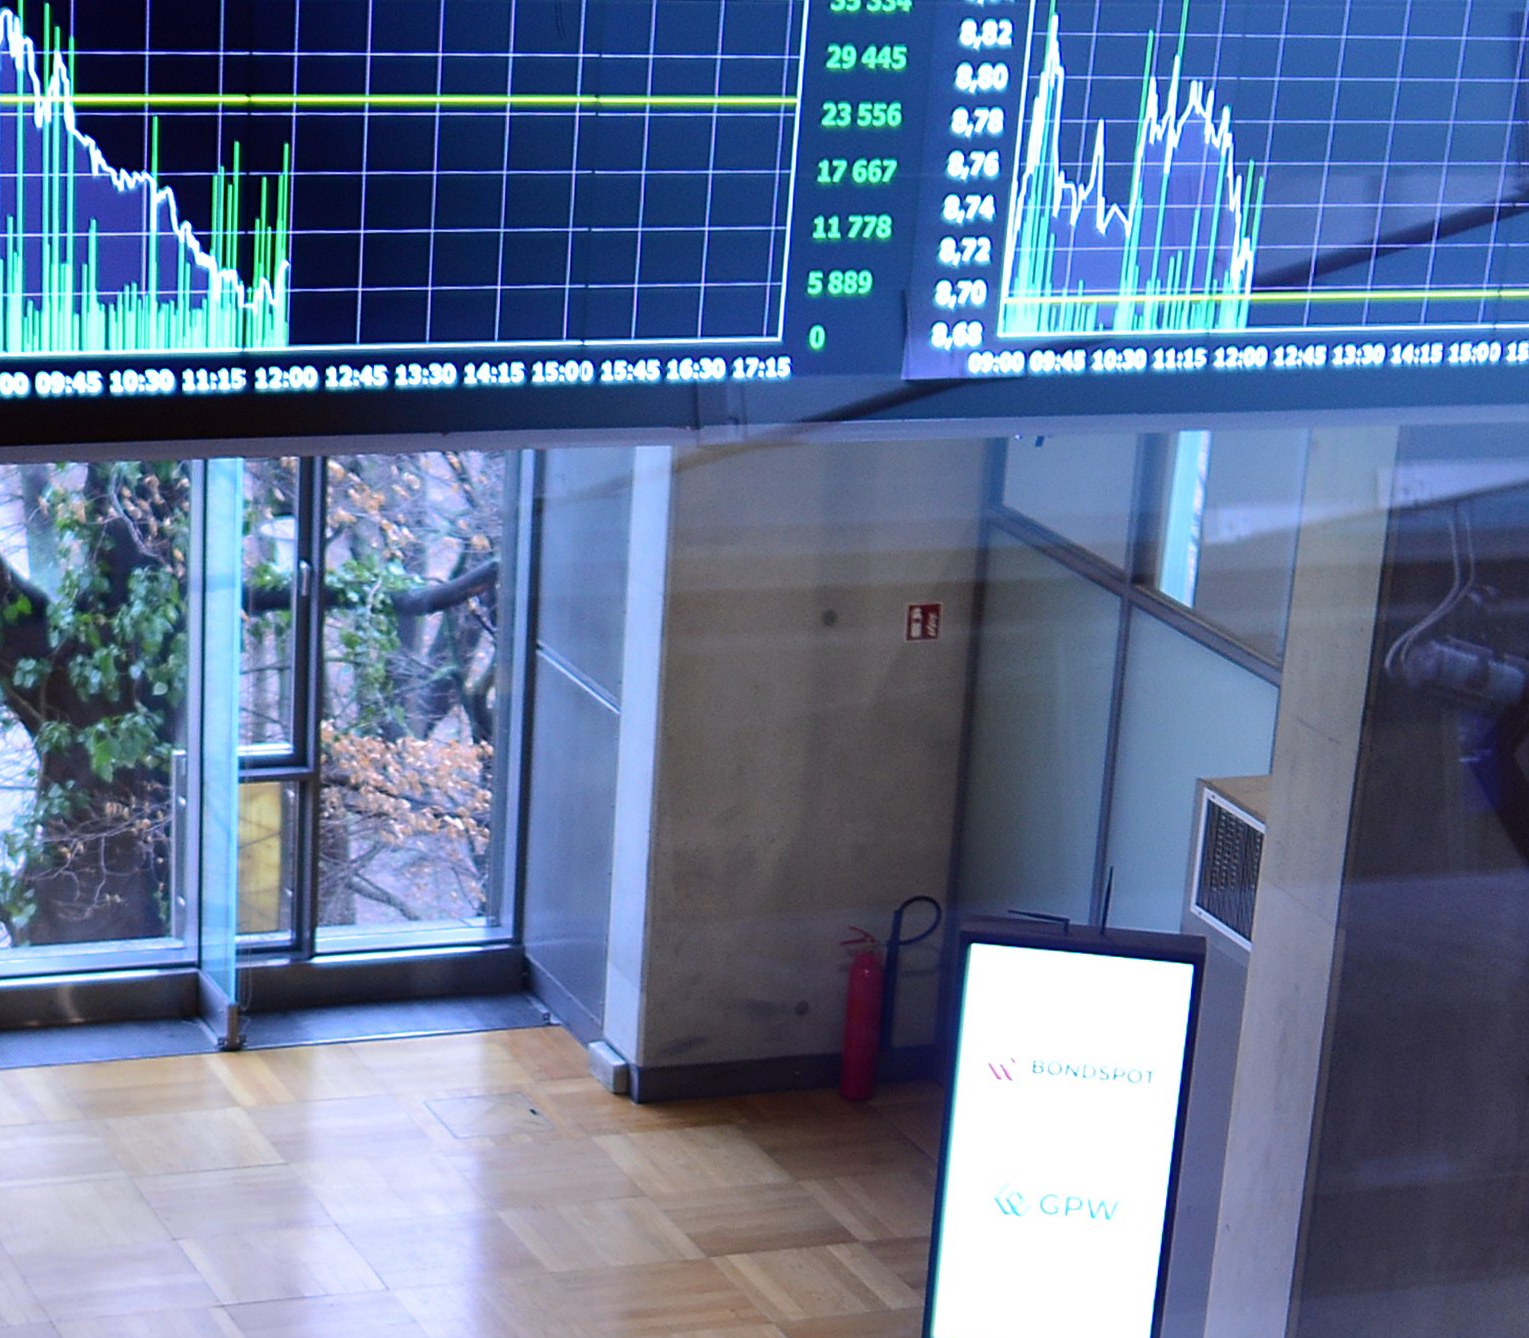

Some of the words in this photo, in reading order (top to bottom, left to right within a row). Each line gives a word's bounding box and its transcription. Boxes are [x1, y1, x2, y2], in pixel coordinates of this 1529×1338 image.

[958, 18, 1014, 50] 8,82
[826, 44, 857, 69] 29
[861, 44, 908, 69] 445
[955, 62, 1009, 94] 8,80
[821, 101, 851, 127] 23
[856, 101, 902, 127] 556
[951, 106, 1005, 138] 8,78
[816, 159, 848, 183] 17
[851, 159, 897, 183] 667
[946, 150, 1000, 181] 8,76
[943, 194, 996, 224] 8,74
[812, 214, 841, 239] 11
[847, 214, 892, 239] 778
[938, 236, 992, 268] 8,72
[807, 270, 824, 295] 5
[827, 270, 873, 295] 889
[934, 279, 988, 310] 8,70
[808, 325, 826, 350] 0
[931, 321, 984, 350] 8,68
[35, 371, 103, 396] 09:45
[109, 369, 175, 394] 10:30
[181, 368, 246, 392] 11:15
[254, 366, 318, 391] 12:00
[325, 364, 389, 389] 12:45
[394, 363, 457, 387] 13:30
[463, 362, 525, 385] 14:15
[531, 360, 594, 383] 15:00
[600, 359, 660, 381] 15:45
[666, 357, 727, 380] 16:30
[731, 356, 791, 379] 17:15
[1032, 1059, 1154, 1084] BONDSPOT
[1040, 1193, 1119, 1220] GPW
